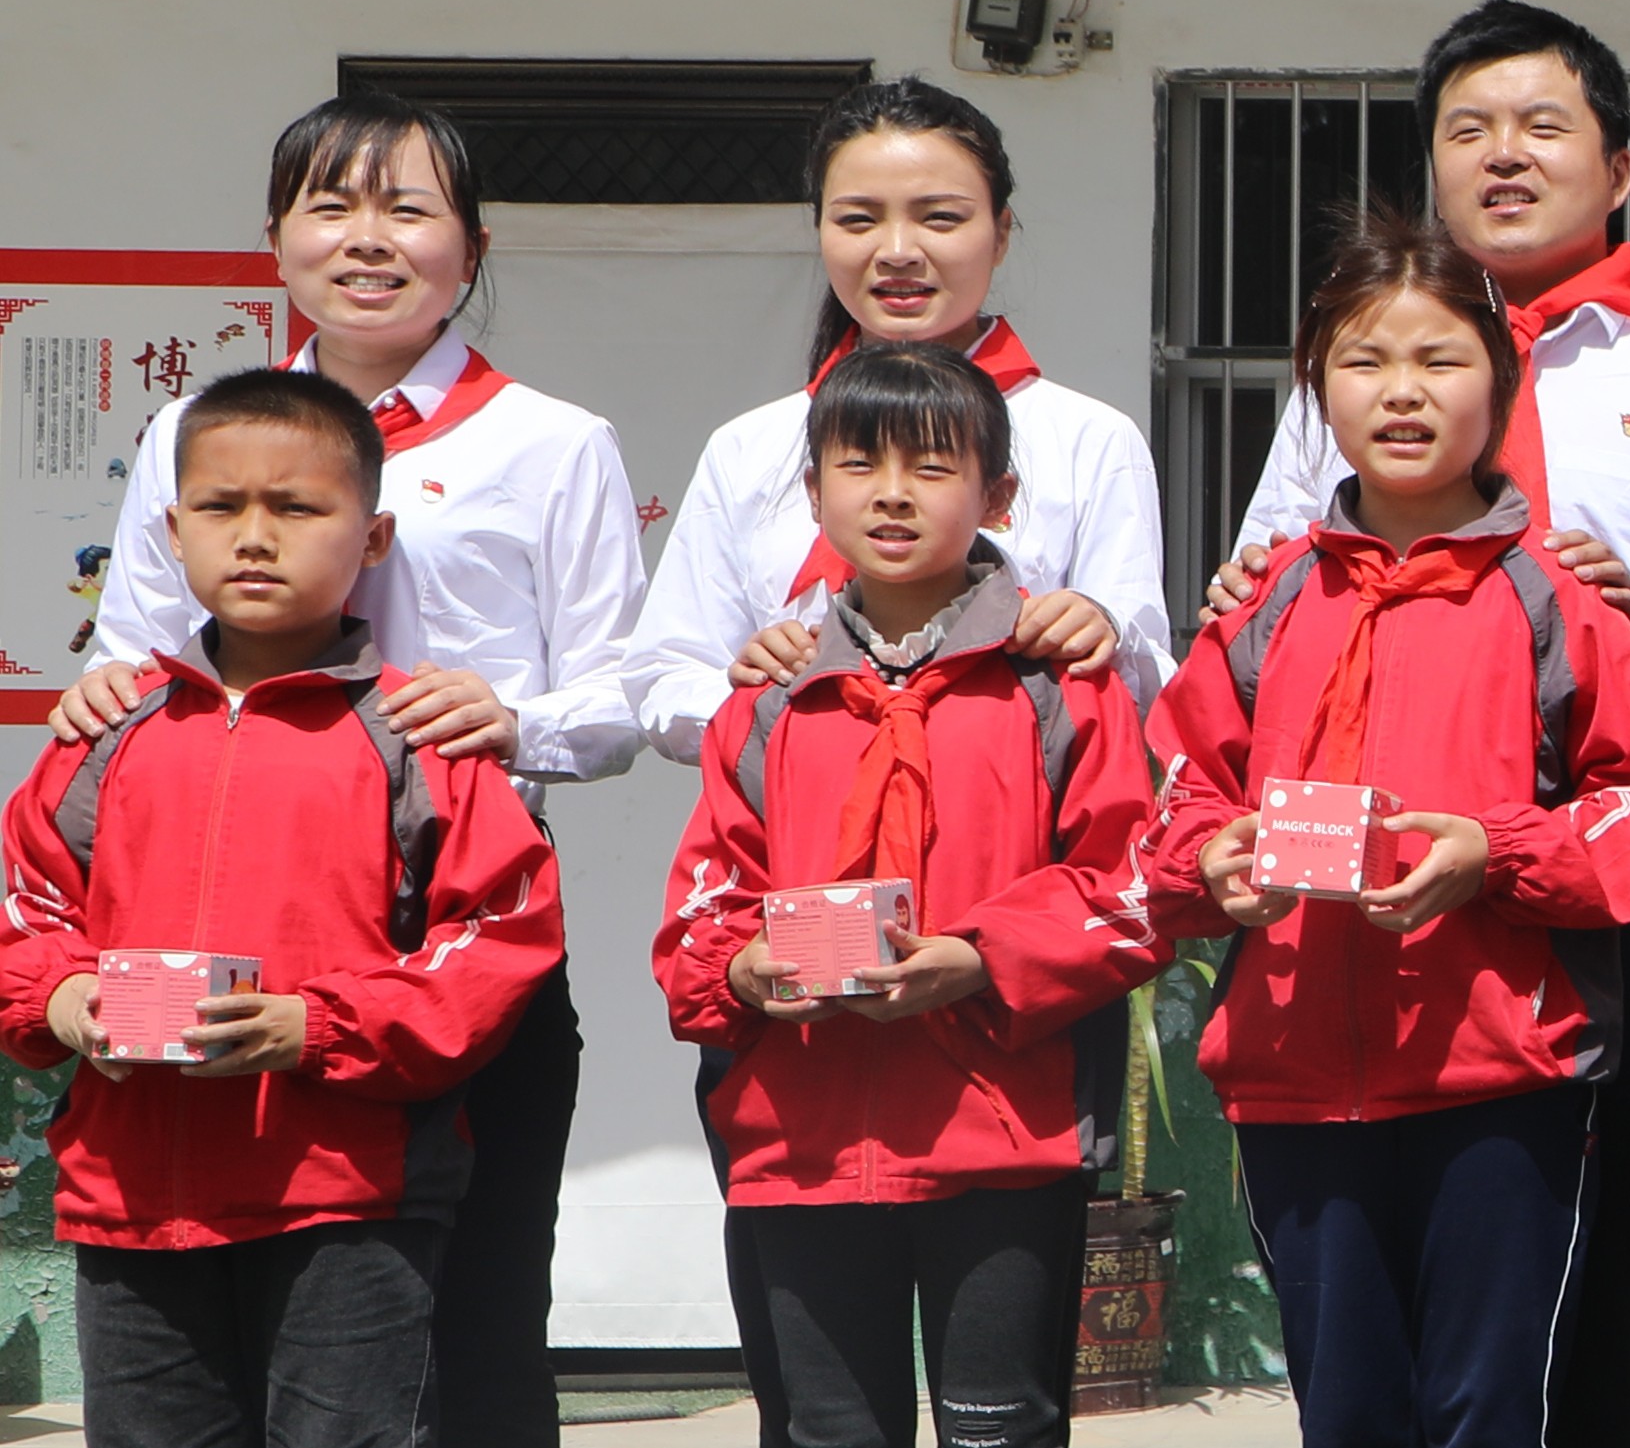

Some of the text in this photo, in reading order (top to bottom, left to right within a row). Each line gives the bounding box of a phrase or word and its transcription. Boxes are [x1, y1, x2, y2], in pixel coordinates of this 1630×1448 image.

[131, 335, 197, 399] 博
[1272, 819, 1354, 837] MAGIC BLOCK
